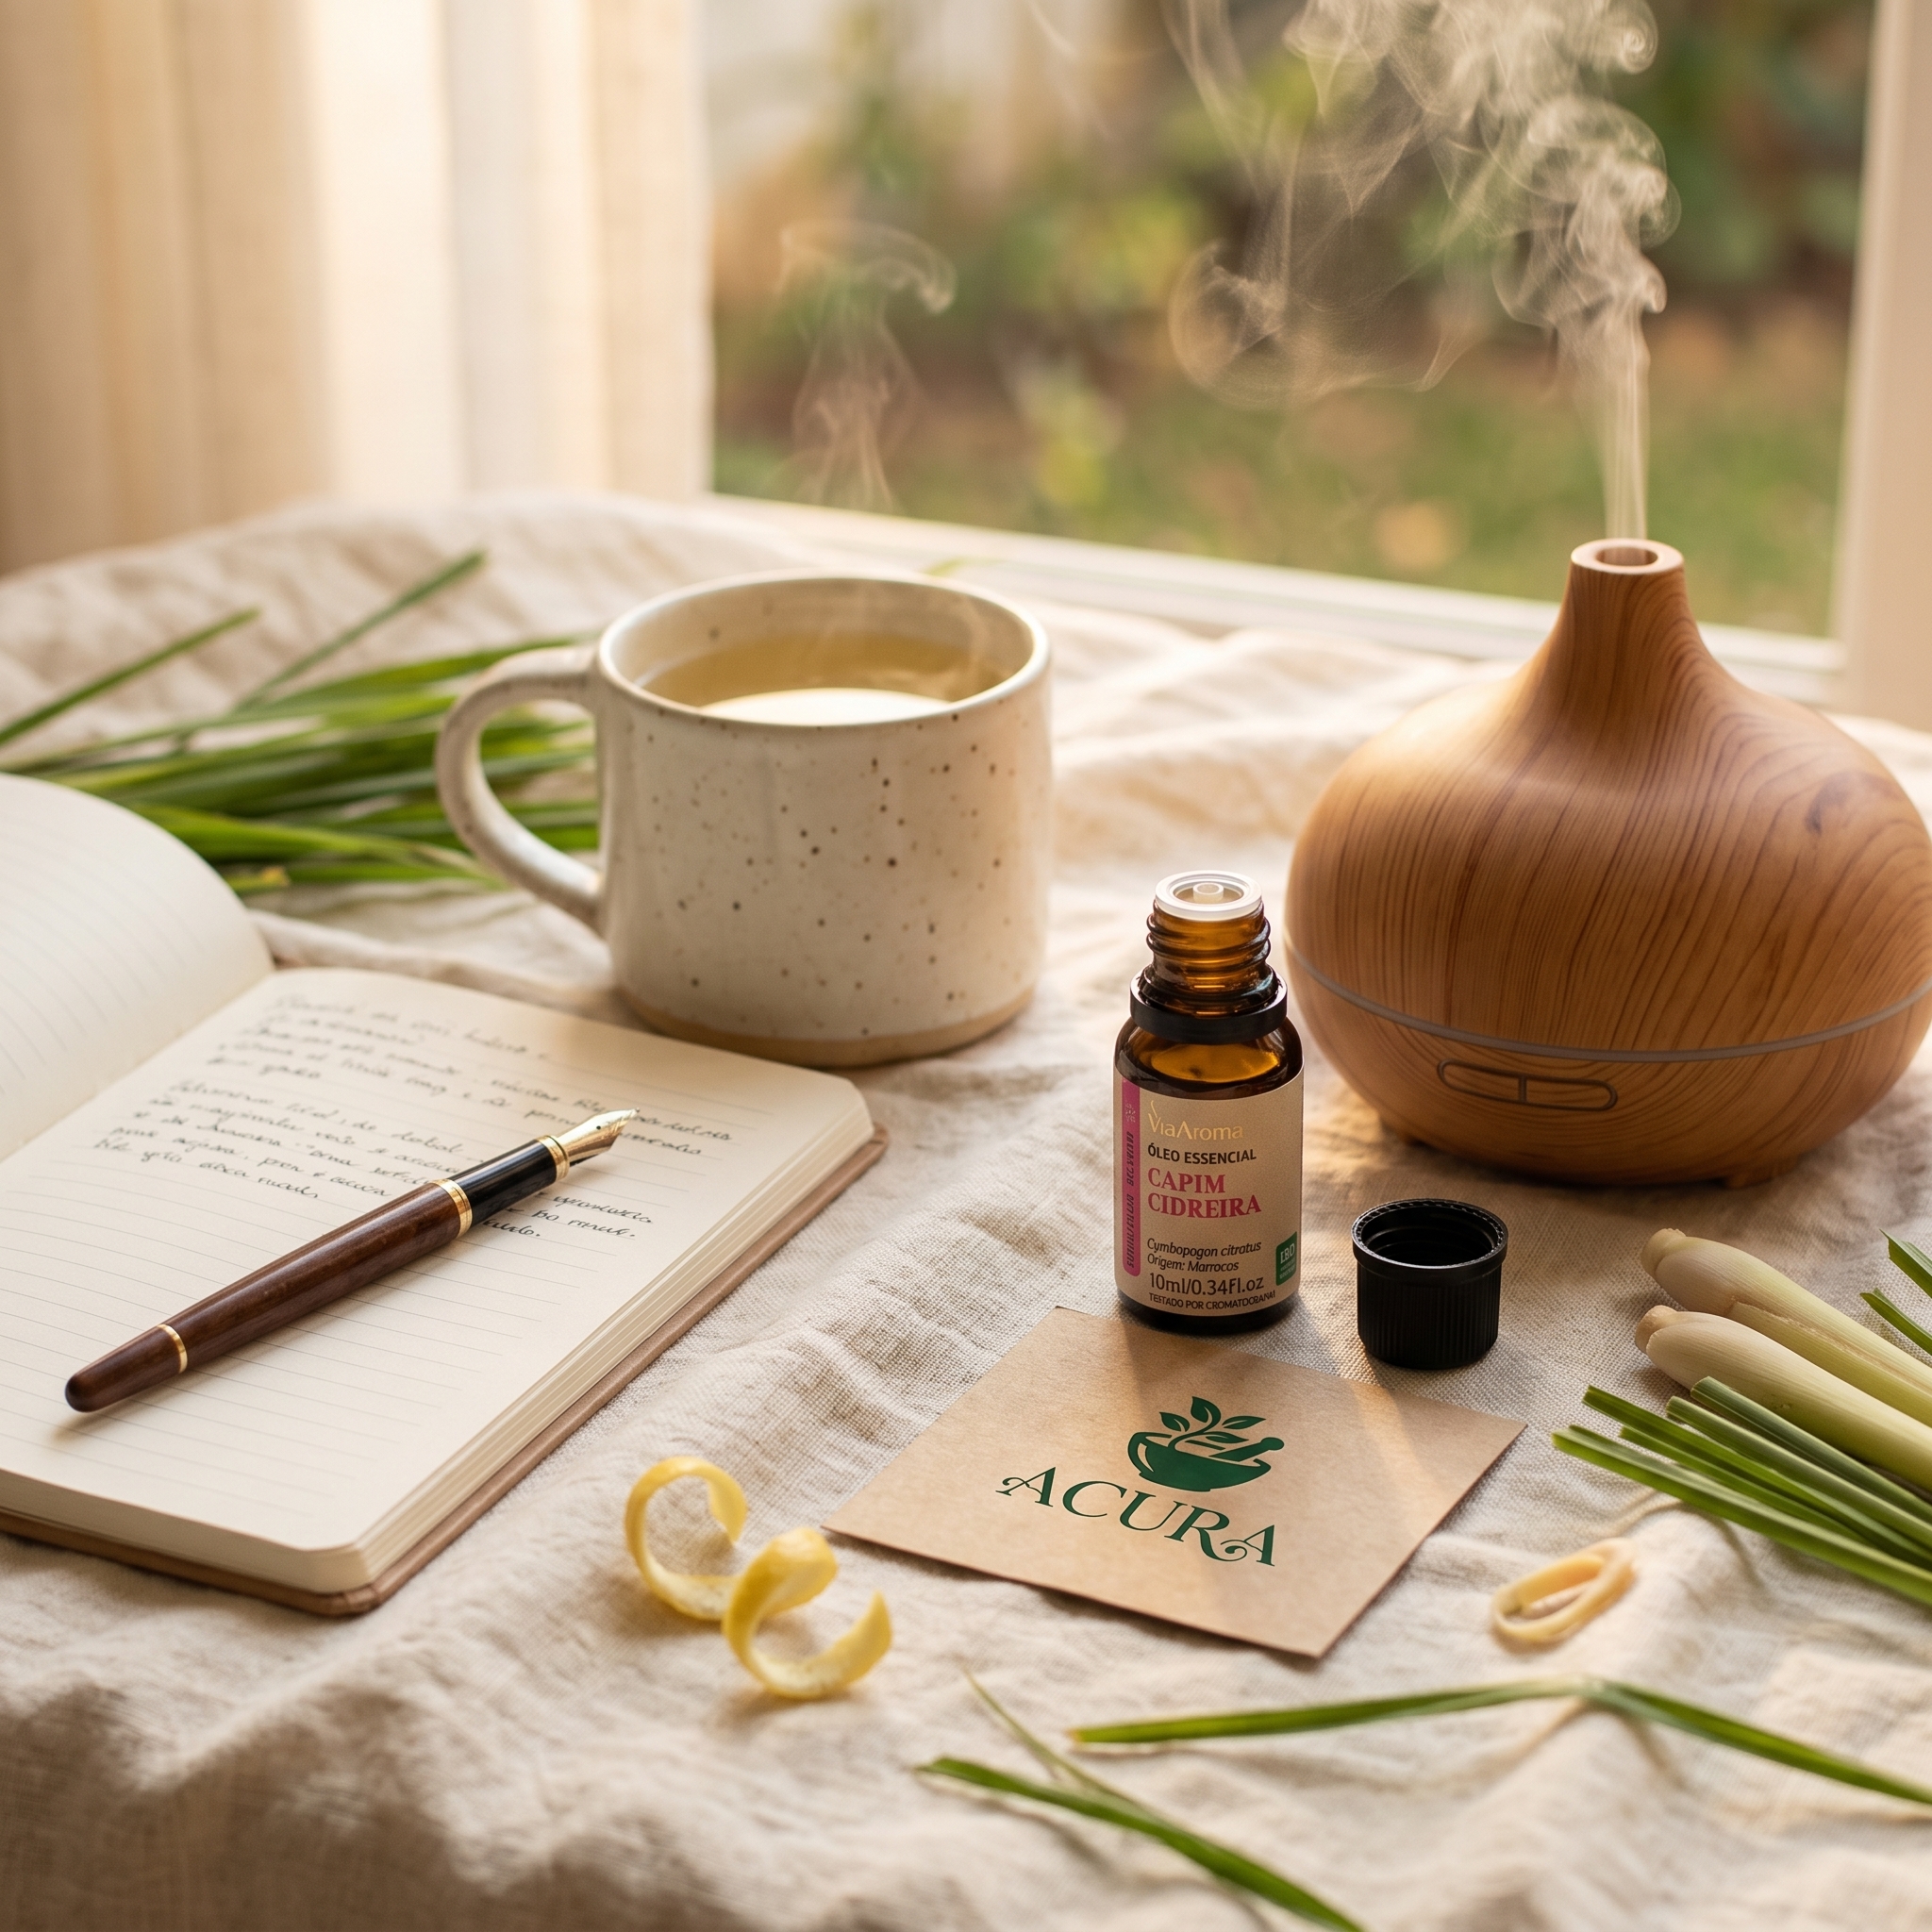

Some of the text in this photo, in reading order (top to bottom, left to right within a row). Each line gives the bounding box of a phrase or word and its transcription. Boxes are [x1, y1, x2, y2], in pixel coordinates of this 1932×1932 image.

[1148, 1111, 1244, 1141] ViaAroma
[1147, 1142, 1257, 1164] ÓLEO ESSENCIAL
[1147, 1168, 1225, 1194] CAPIM
[1147, 1192, 1262, 1218] CIDREIRA
[1147, 1238, 1262, 1260] Cymbopogon citratus
[1147, 1253, 1240, 1273] Origem: Marrocos
[1185, 1300, 1205, 1310] POR
[995, 1466, 1276, 1567] ACURA
